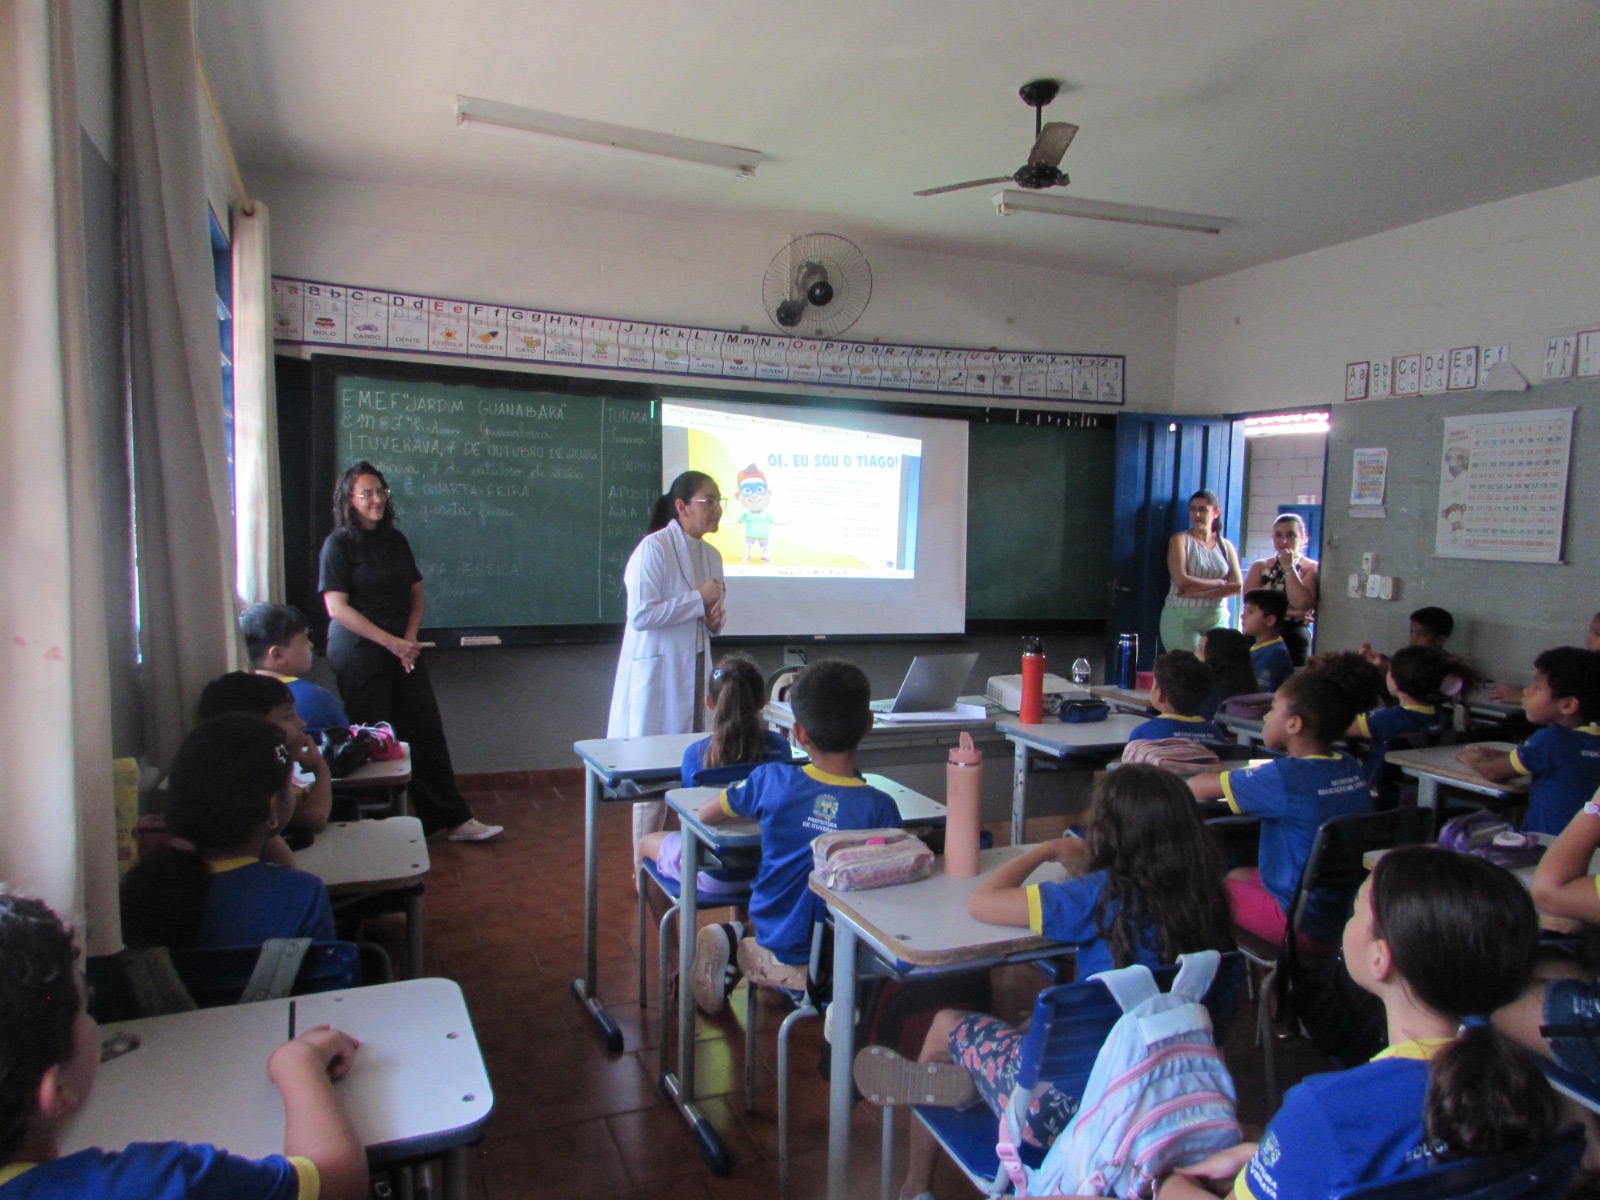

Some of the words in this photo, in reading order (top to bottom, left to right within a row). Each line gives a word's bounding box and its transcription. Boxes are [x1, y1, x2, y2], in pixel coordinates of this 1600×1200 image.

[288, 285, 298, 294] a
[309, 286, 320, 296] B
[331, 289, 340, 298] b
[352, 291, 363, 300] C
[394, 296, 404, 306] D
[414, 300, 424, 308] d
[434, 302, 444, 311] E
[454, 305, 463, 314] e
[474, 306, 483, 315] F
[495, 308, 500, 317] f
[512, 311, 524, 320] G
[532, 312, 541, 322] g
[550, 315, 560, 324] H
[569, 318, 578, 326] h
[660, 328, 670, 336] K
[695, 332, 702, 340] L
[727, 334, 738, 343] M
[760, 338, 771, 346] N
[793, 340, 803, 350] O
[1022, 356, 1034, 364] W
[1050, 356, 1057, 364] X
[606, 408, 648, 424] TURMA
[464, 442, 481, 456] DE
[487, 446, 544, 458] OUTUBRO
[550, 448, 564, 459] DE
[768, 454, 788, 468] OI,
[793, 454, 809, 468] EU
[814, 454, 839, 468] SOU
[844, 454, 852, 467] O
[856, 455, 898, 469] TIAGO!
[808, 816, 838, 828] PREFEITURA
